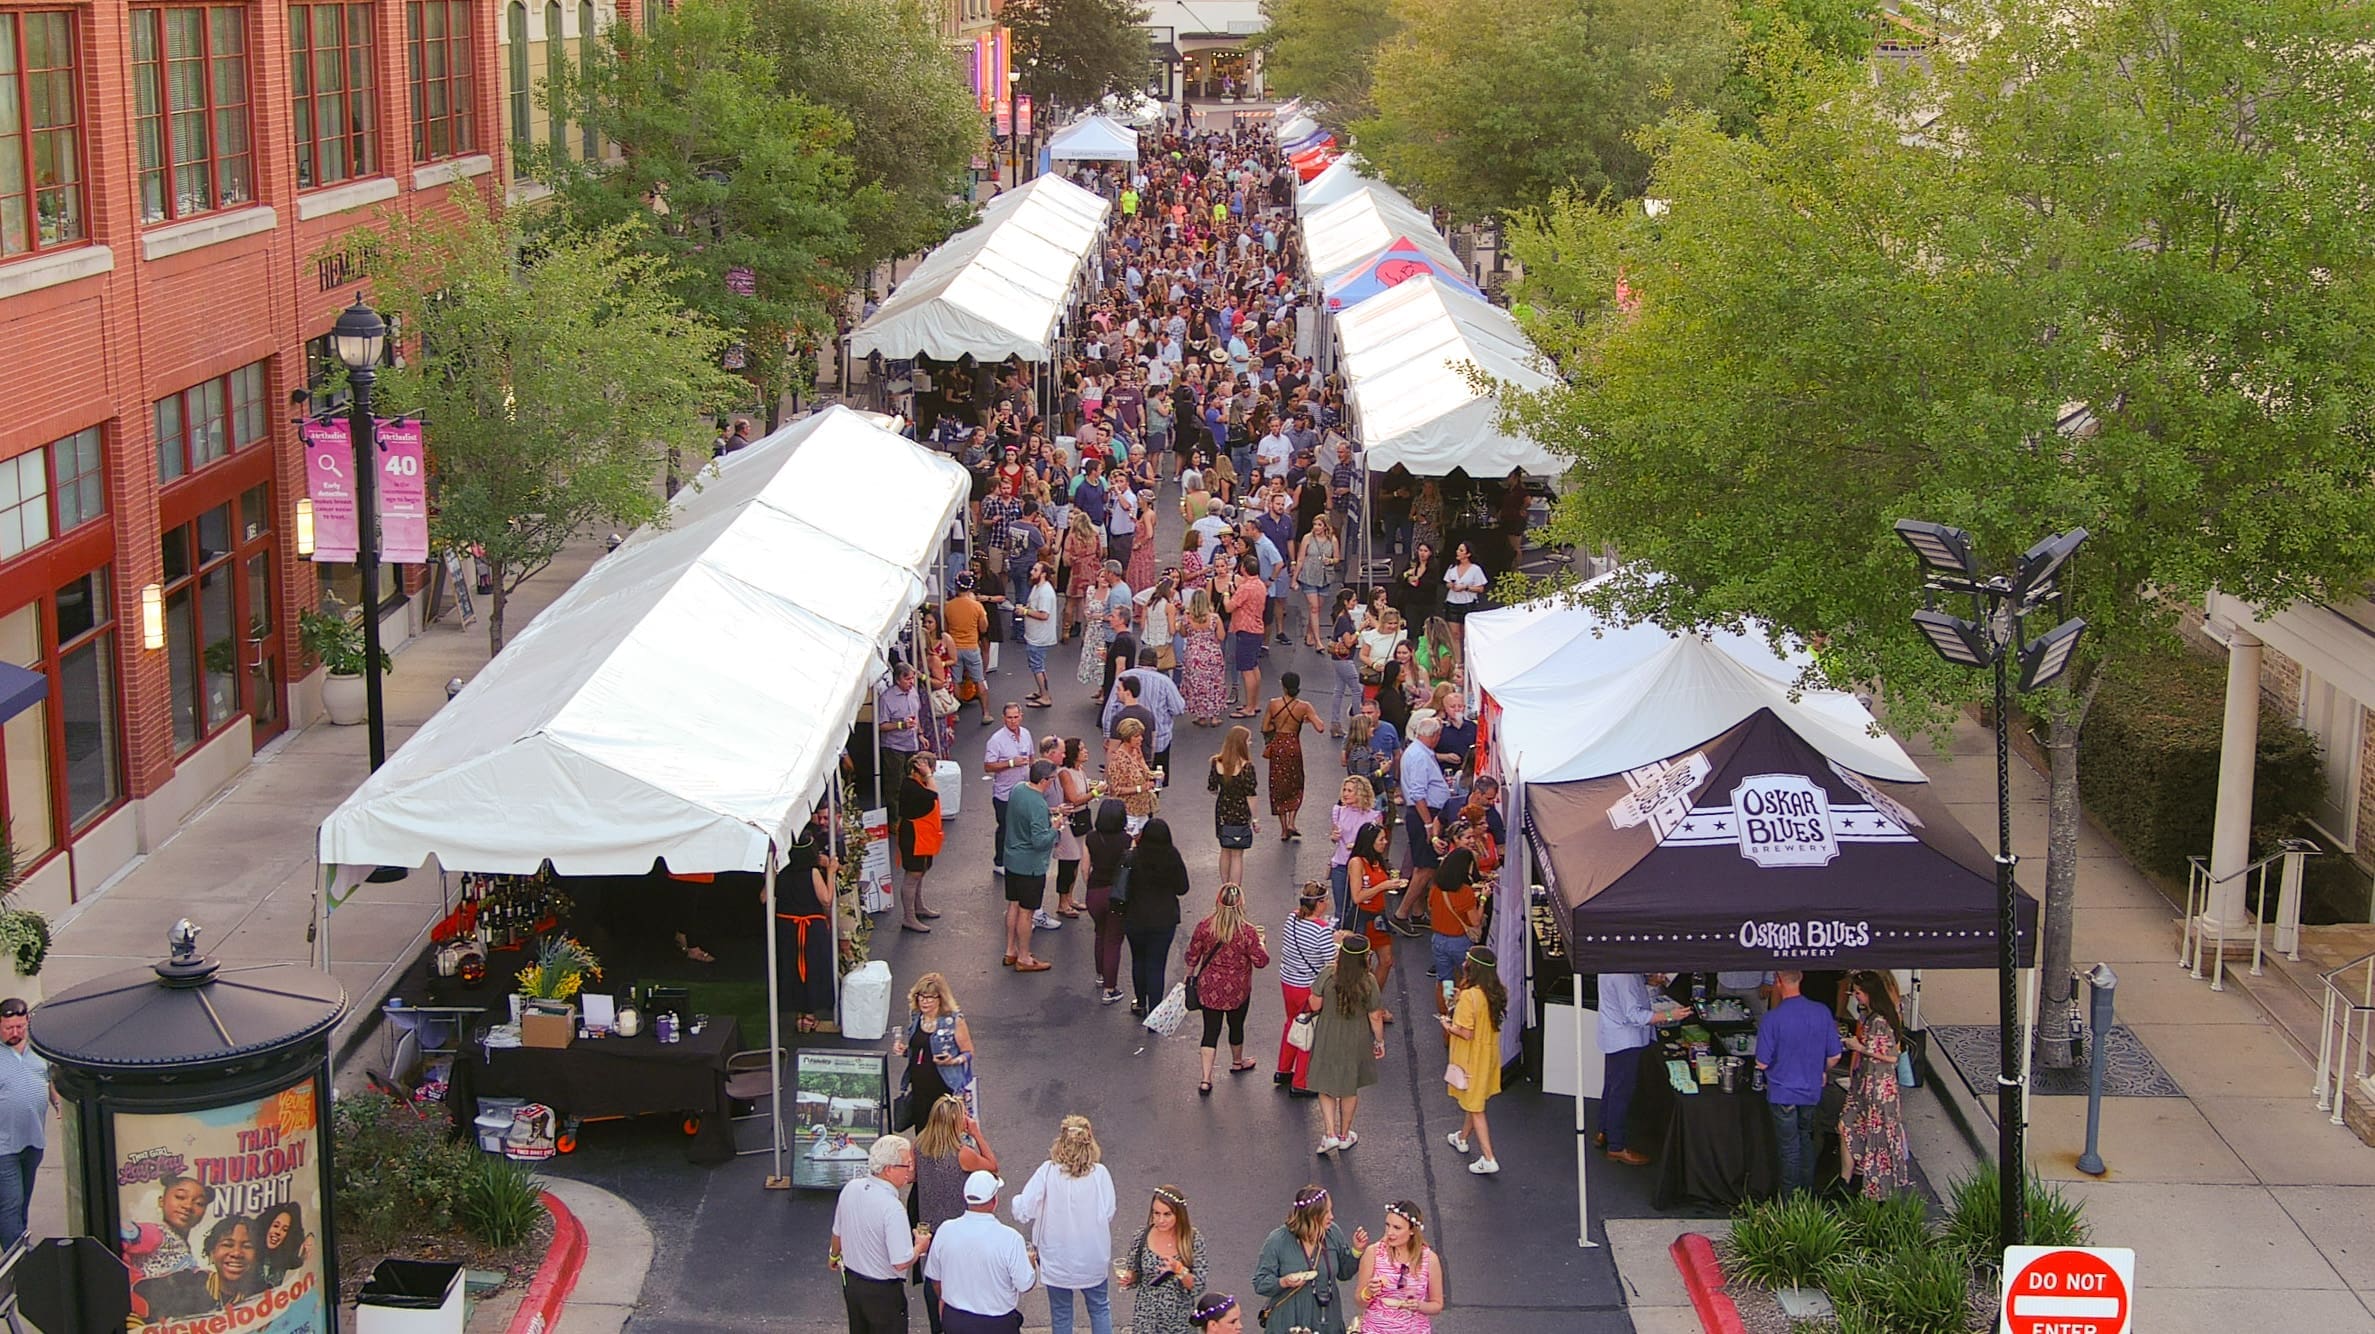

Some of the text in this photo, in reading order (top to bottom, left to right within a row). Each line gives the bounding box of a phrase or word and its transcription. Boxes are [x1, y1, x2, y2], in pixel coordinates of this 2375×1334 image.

[384, 455, 417, 476] 40
[322, 481, 341, 490] Early
[1743, 788, 1820, 817] OSKAR
[1746, 817, 1826, 844] BLUES
[1752, 845, 1827, 854] BREWERY
[1739, 920, 1869, 948] OSKAR BLUES
[1773, 949, 1836, 957] BREWERY
[237, 1125, 281, 1152] THAT
[194, 1138, 307, 1185] THURSDAY
[212, 1174, 293, 1217] NIGHT
[2029, 1271, 2107, 1291] DO NOT
[2032, 1323, 2098, 1334] ENTER
